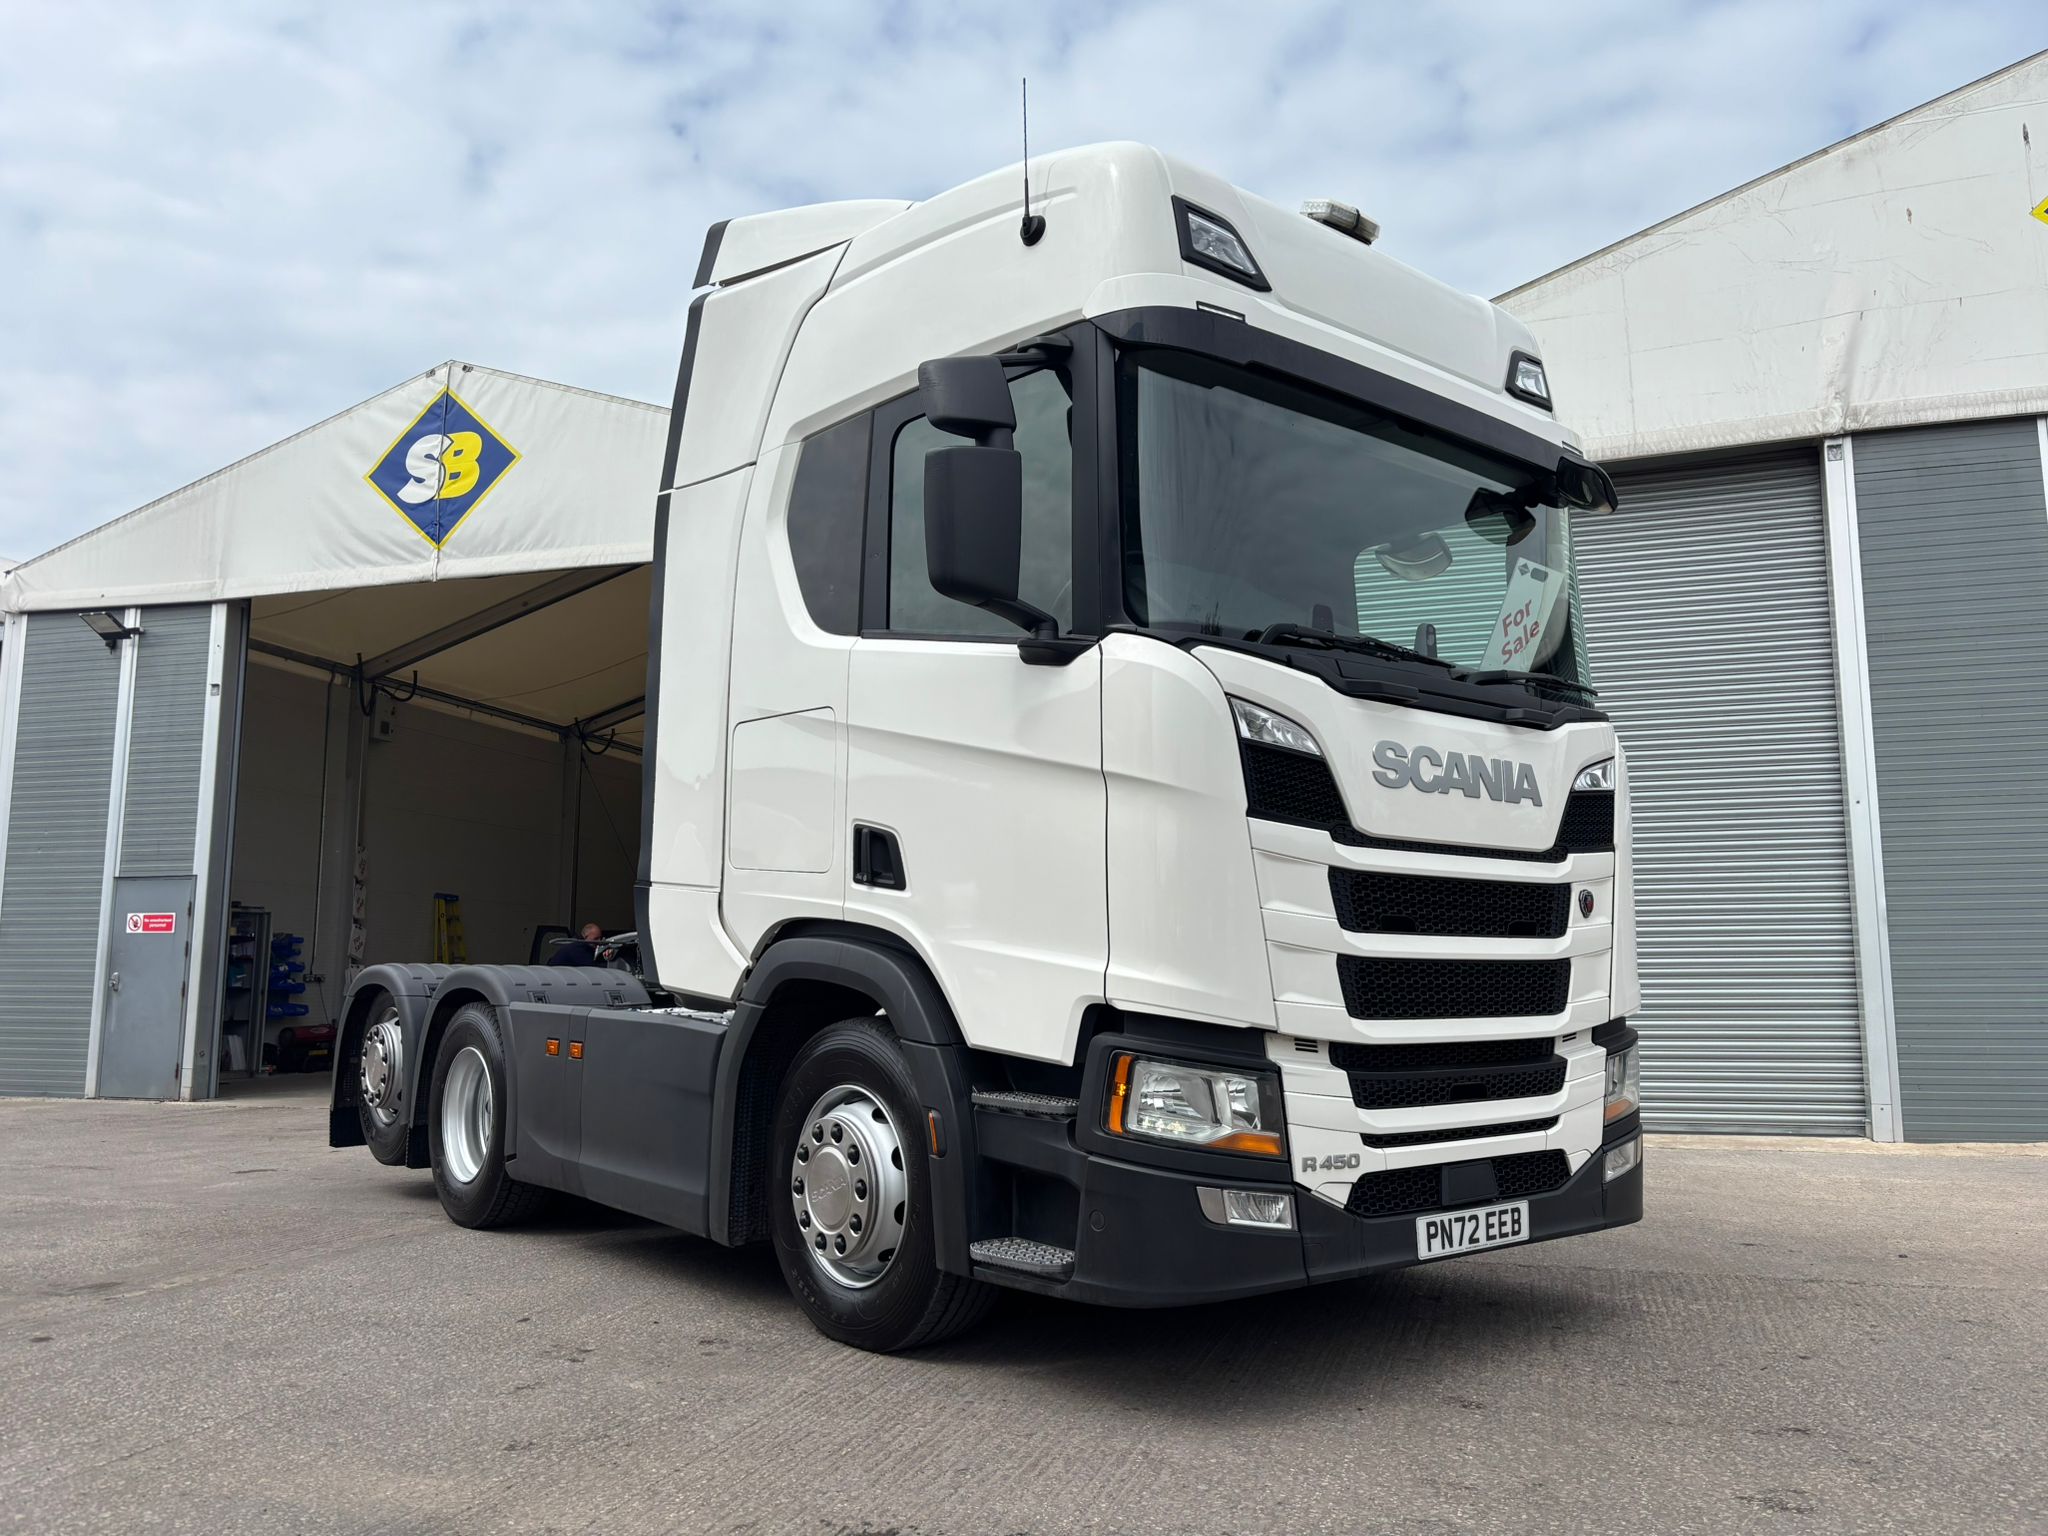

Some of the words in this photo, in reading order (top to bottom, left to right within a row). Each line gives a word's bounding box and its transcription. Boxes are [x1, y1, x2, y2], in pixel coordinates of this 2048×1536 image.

[396, 431, 483, 504] SB
[1502, 600, 1532, 638] For
[1501, 620, 1540, 665] Sale
[1372, 740, 1543, 807] SCANIA
[1302, 1156, 1317, 1172] R
[1319, 1153, 1360, 1170] 450
[1426, 1214, 1480, 1252] PN72
[1485, 1206, 1521, 1242] EEB
